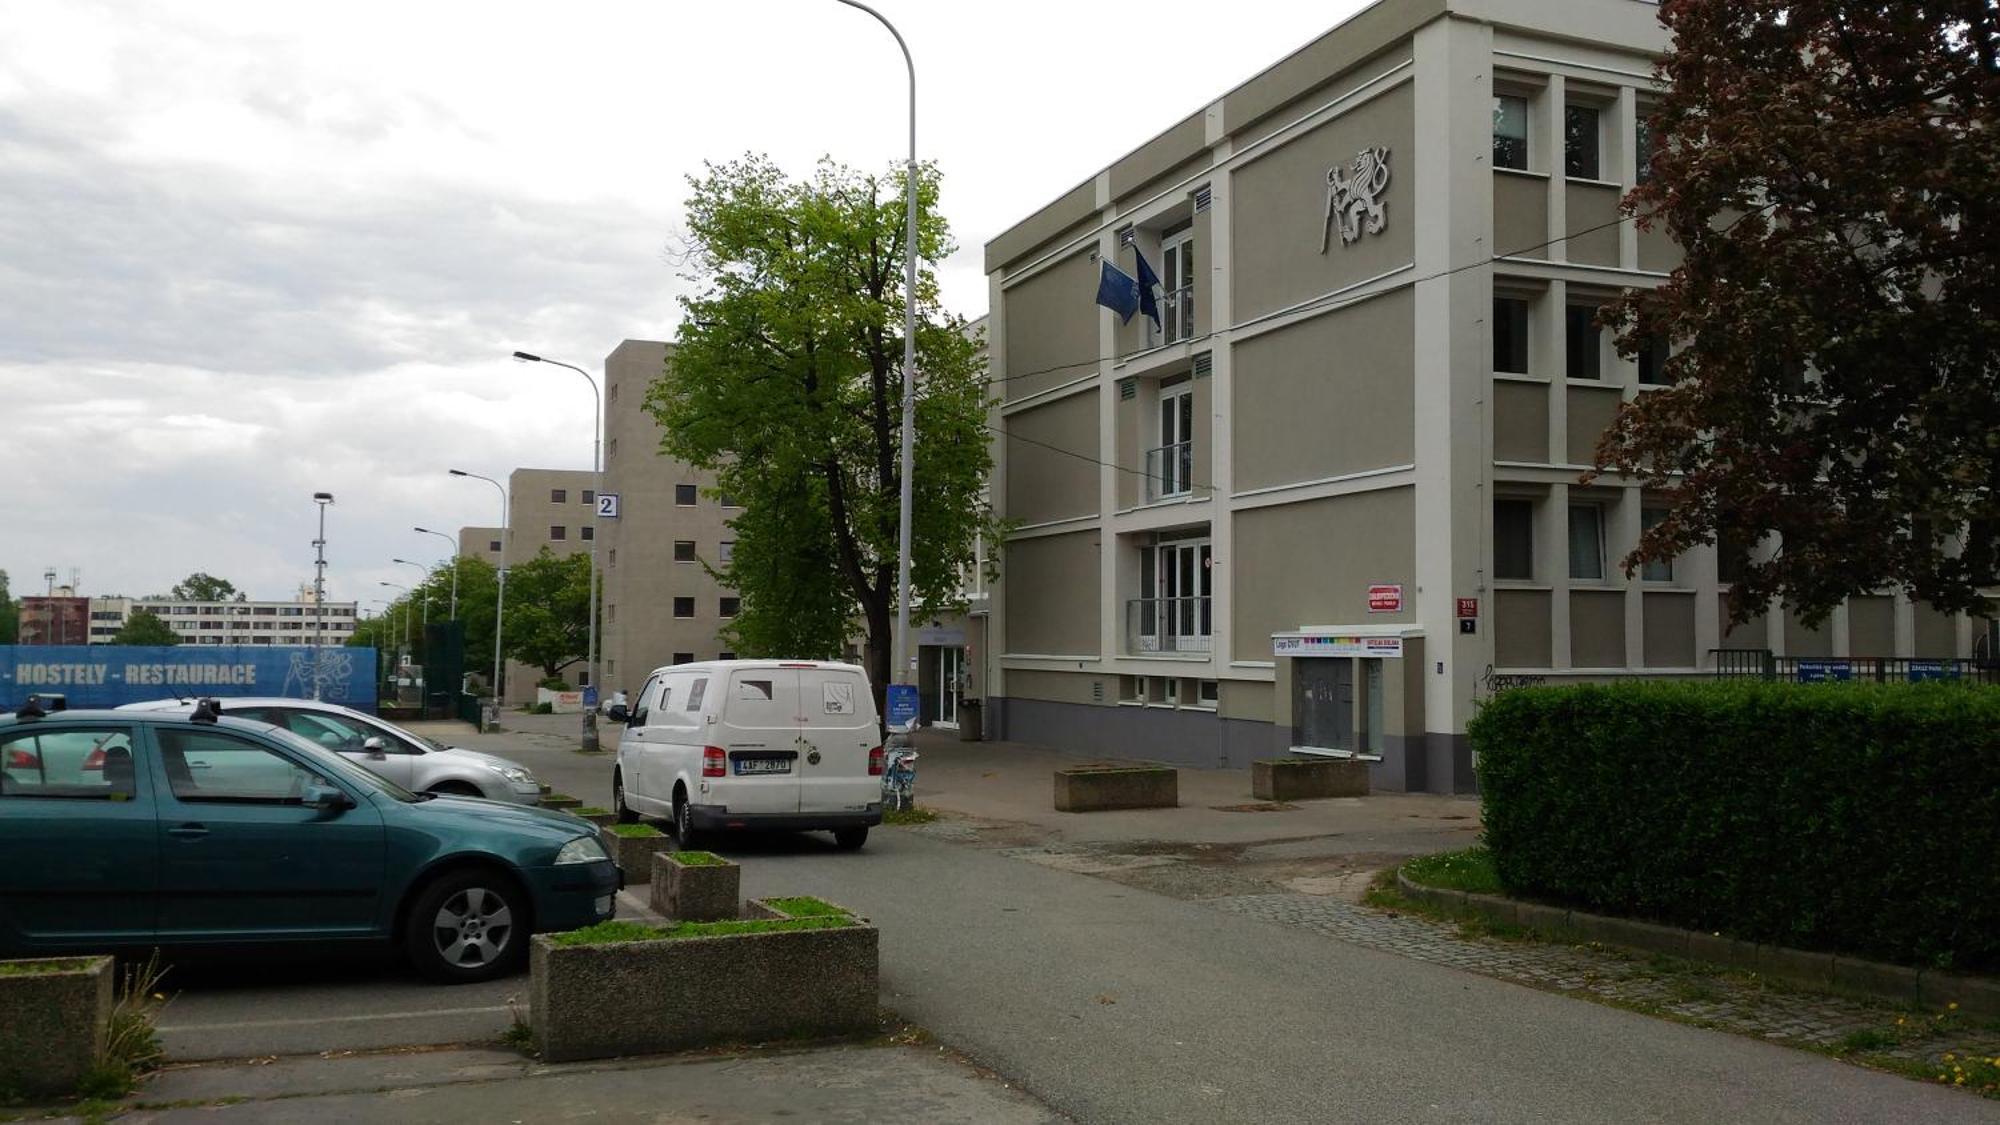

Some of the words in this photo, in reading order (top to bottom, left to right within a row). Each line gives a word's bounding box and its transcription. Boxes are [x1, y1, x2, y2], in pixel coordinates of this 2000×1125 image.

[600, 497, 613, 514] 2
[16, 663, 107, 685] HOSTELY
[125, 664, 257, 685] RESTAURACE
